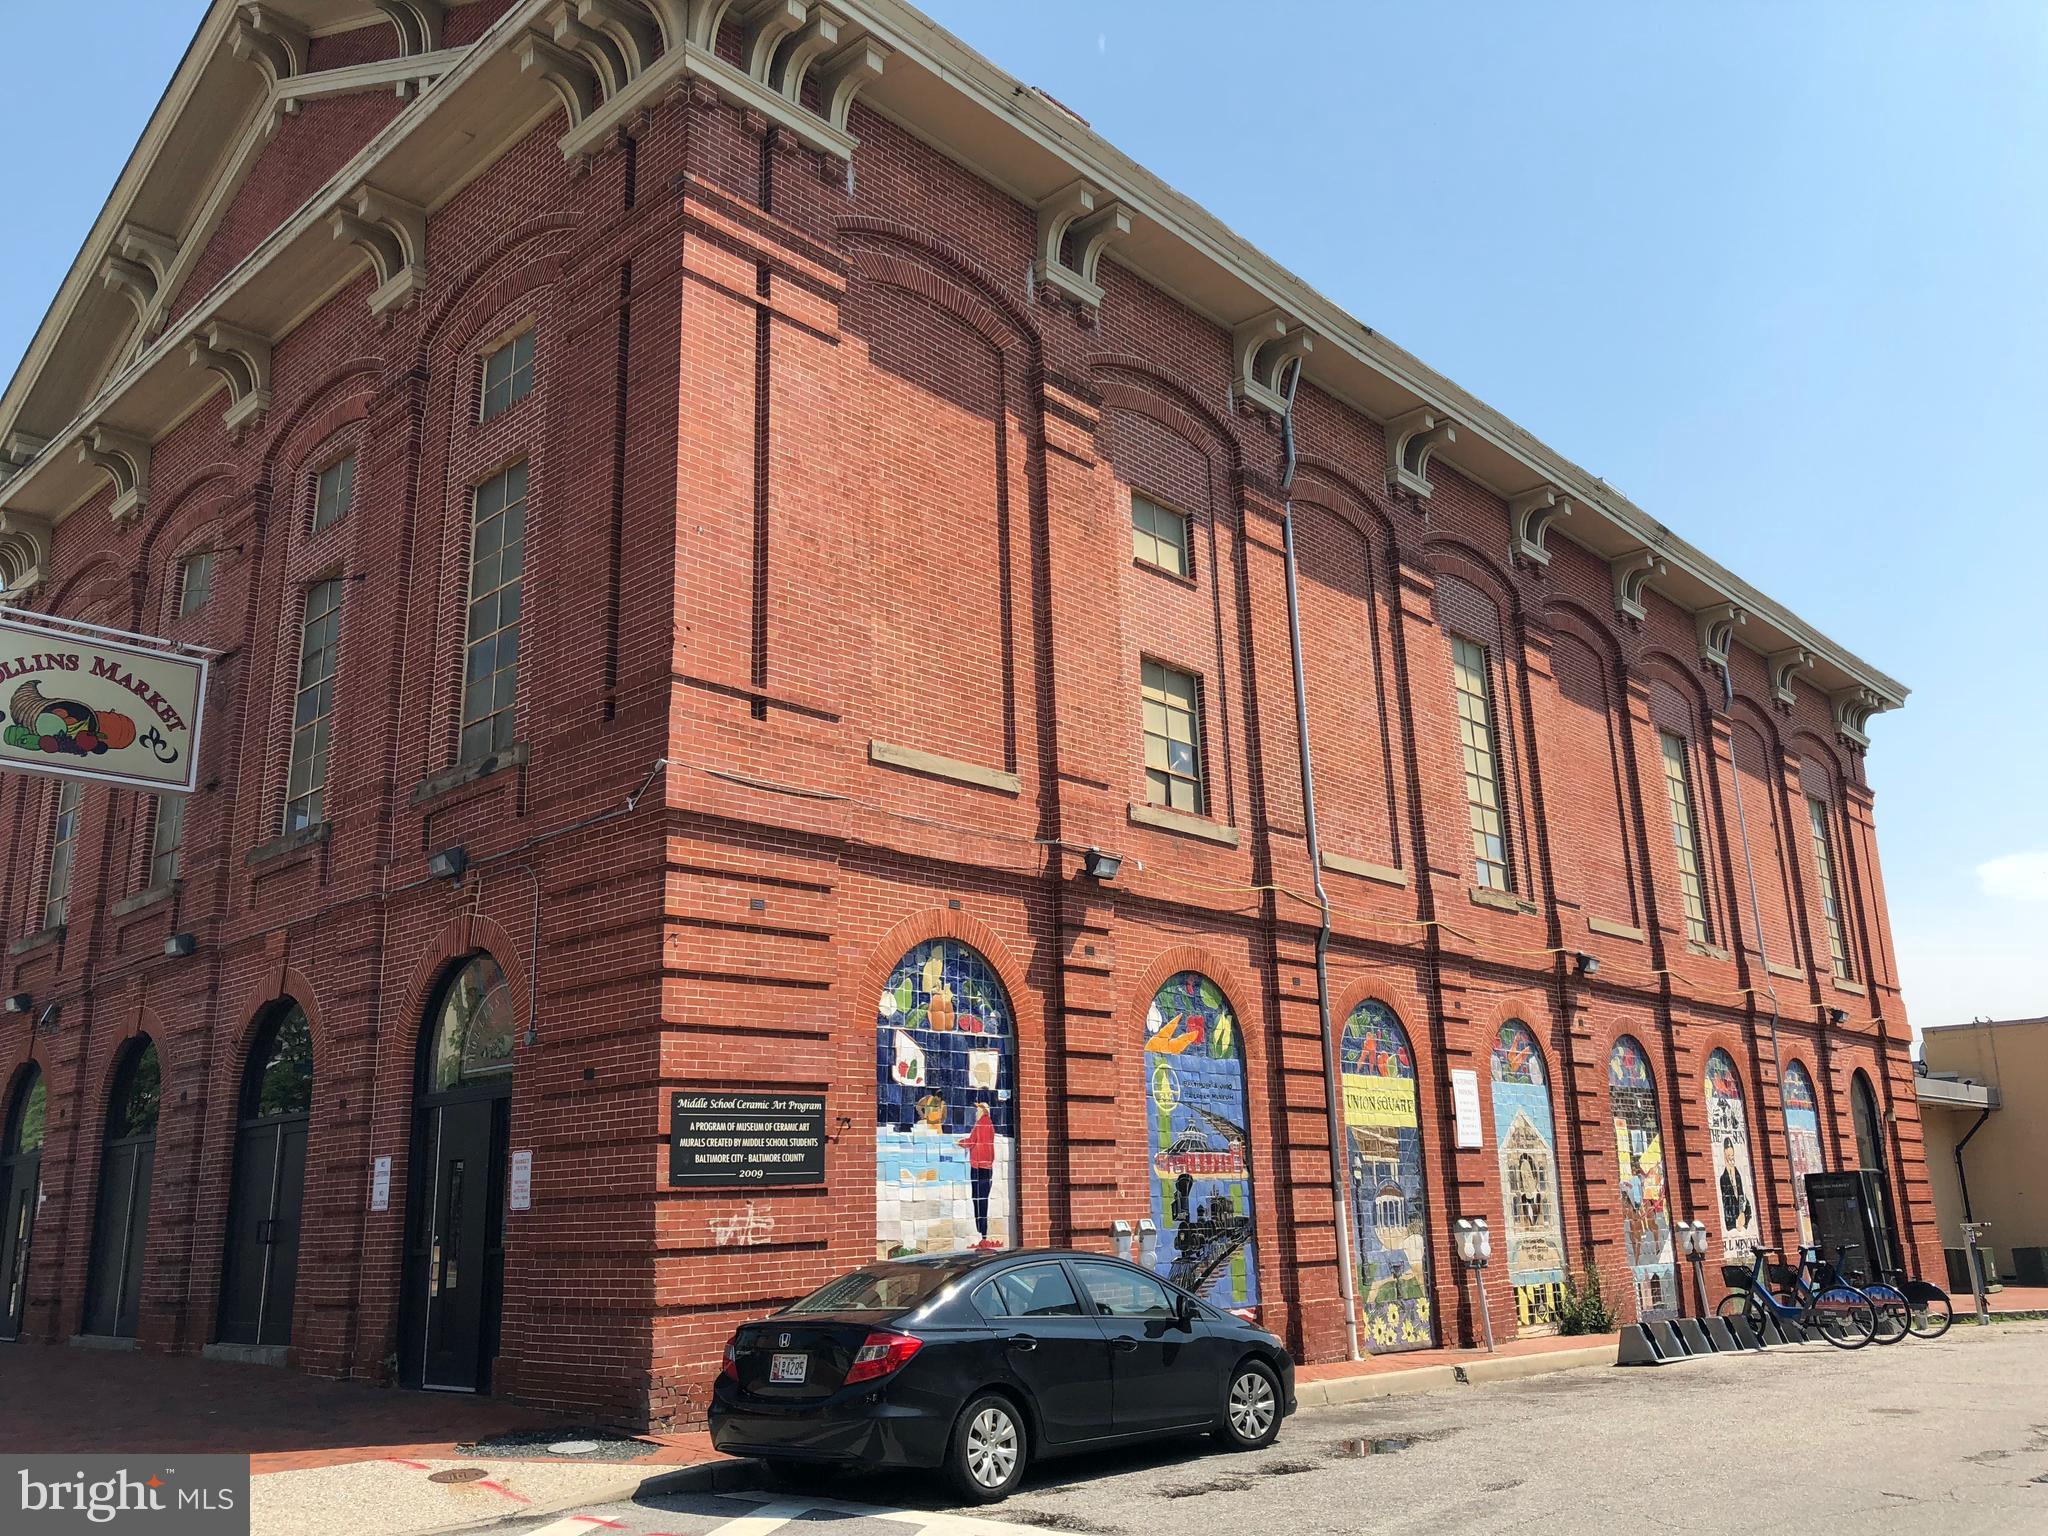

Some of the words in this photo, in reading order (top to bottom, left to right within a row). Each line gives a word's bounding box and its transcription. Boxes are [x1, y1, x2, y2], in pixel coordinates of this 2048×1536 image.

[88, 655, 187, 733] MARKET
[677, 1098, 708, 1109] Middle
[710, 1098, 737, 1110] School
[737, 1099, 770, 1110] Ceramic
[771, 1100, 786, 1110] Art
[788, 1100, 822, 1113] Program
[1346, 1094, 1376, 1111] UNION
[1377, 1096, 1413, 1113] SQUARE
[690, 1122, 695, 1131] A
[696, 1122, 726, 1131] PROGRAM
[727, 1122, 735, 1131] OF
[736, 1122, 764, 1131] MUSEUM
[765, 1122, 773, 1131] OF
[774, 1122, 798, 1131] CERAMIC
[799, 1122, 810, 1131] ART
[680, 1138, 706, 1147] MURALS
[706, 1138, 732, 1147] CREATED
[733, 1138, 742, 1147] BY
[742, 1138, 765, 1147] MIDDLE
[765, 1138, 789, 1147] SCHOOL
[790, 1138, 819, 1147] STUDENTS
[695, 1154, 730, 1163] BALTIMORE
[730, 1154, 744, 1163] CITY
[748, 1154, 781, 1163] BALTIMORE
[782, 1153, 805, 1162] COUNTY
[739, 1170, 764, 1178] 2009
